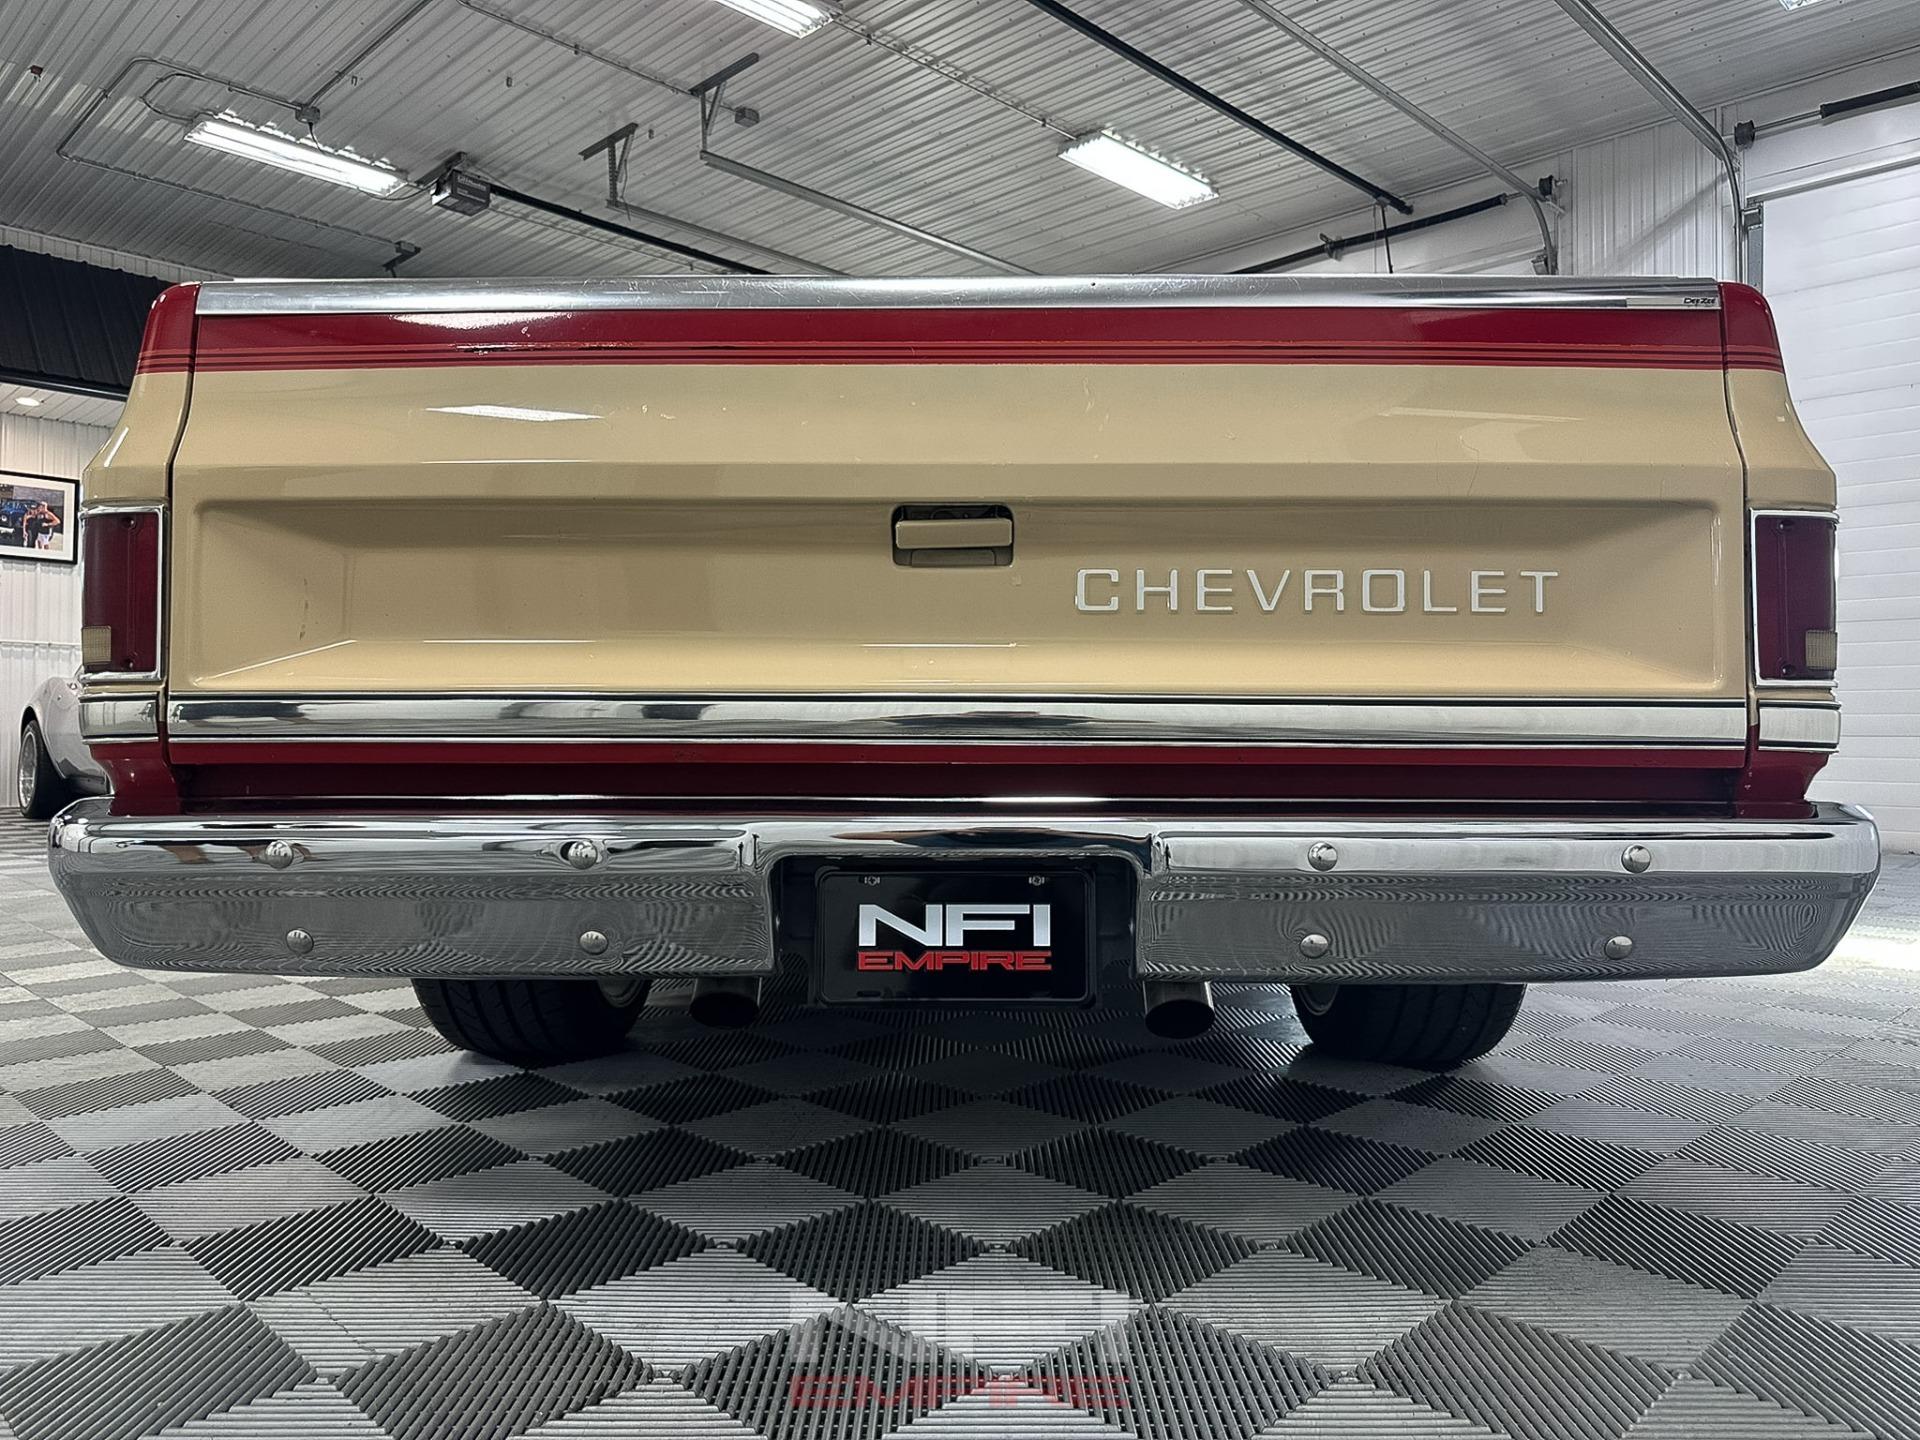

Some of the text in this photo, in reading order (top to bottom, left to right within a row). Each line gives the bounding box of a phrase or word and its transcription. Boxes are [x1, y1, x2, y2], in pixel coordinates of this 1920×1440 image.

[1075, 568, 1559, 613] CHEVROLET
[858, 904, 1051, 947] NFI
[857, 951, 1052, 971] EMPIRE
